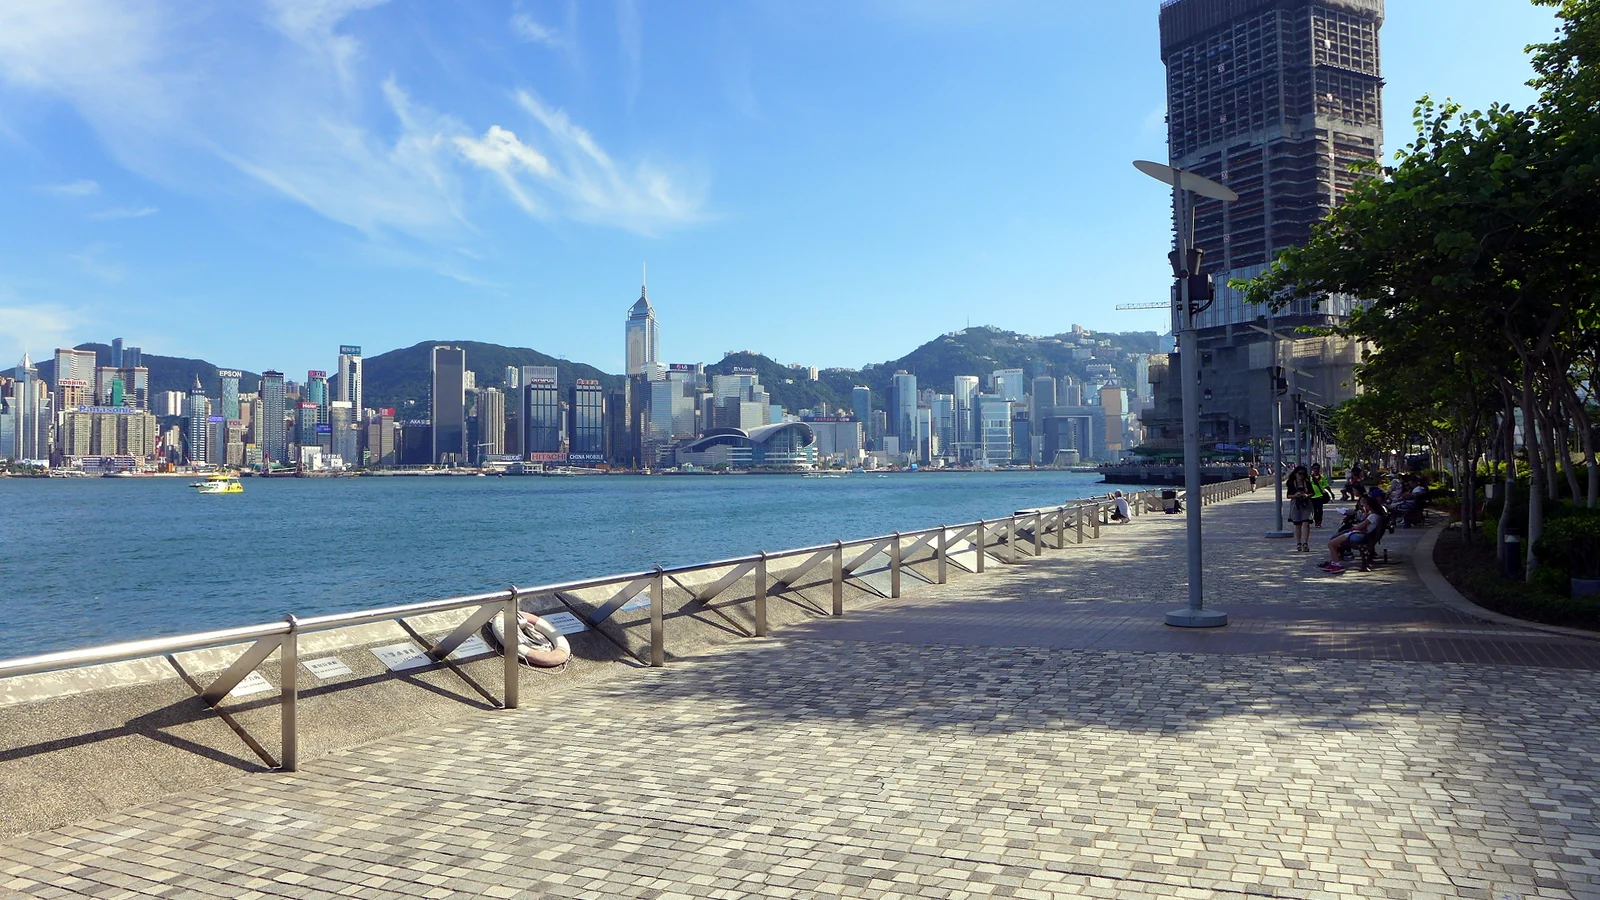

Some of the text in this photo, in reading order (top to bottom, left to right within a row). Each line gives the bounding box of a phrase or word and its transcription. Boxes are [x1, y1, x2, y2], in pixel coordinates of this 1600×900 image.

[219, 370, 242, 378] EPSON
[79, 404, 135, 414] Panasonic
[532, 453, 567, 461] HITACHI
